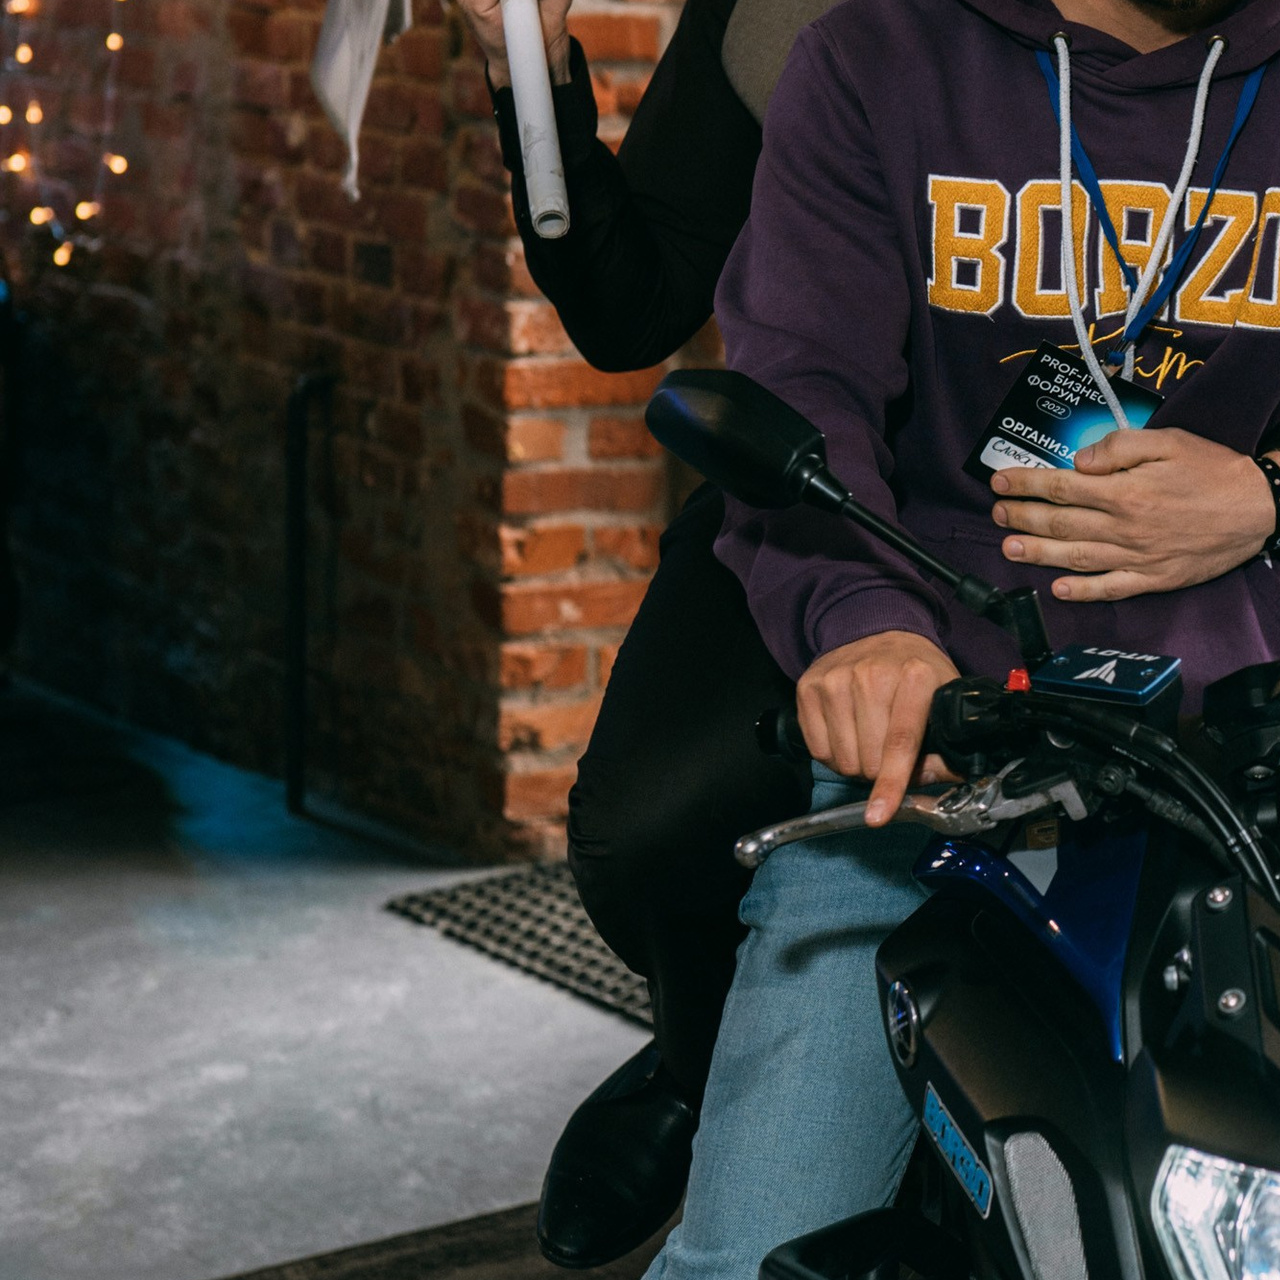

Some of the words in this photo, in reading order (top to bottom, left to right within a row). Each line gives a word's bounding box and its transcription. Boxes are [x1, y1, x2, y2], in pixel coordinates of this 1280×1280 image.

[1040, 354, 1094, 385] PROF-IT
[1027, 375, 1080, 406] ФОРУМ
[1054, 374, 1107, 404] БИЗНЕС
[1041, 400, 1066, 415] 2022
